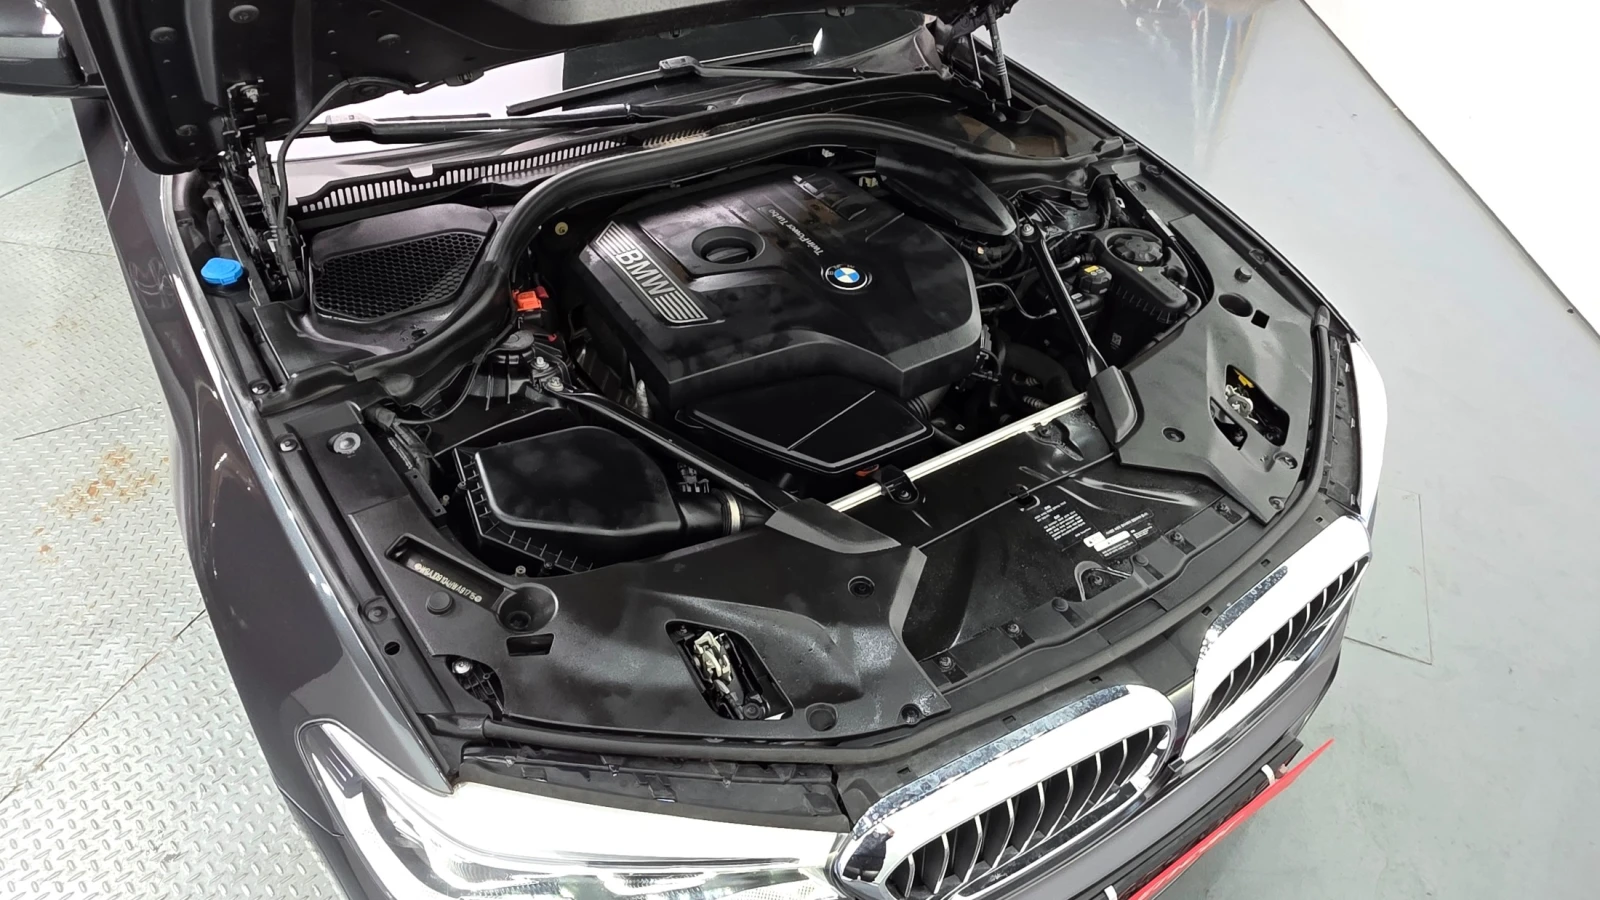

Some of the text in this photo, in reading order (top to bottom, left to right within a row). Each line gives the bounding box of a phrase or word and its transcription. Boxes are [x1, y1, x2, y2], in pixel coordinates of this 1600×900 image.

[768, 208, 824, 256] TwinPower Turbo
[615, 249, 676, 296] BMW
